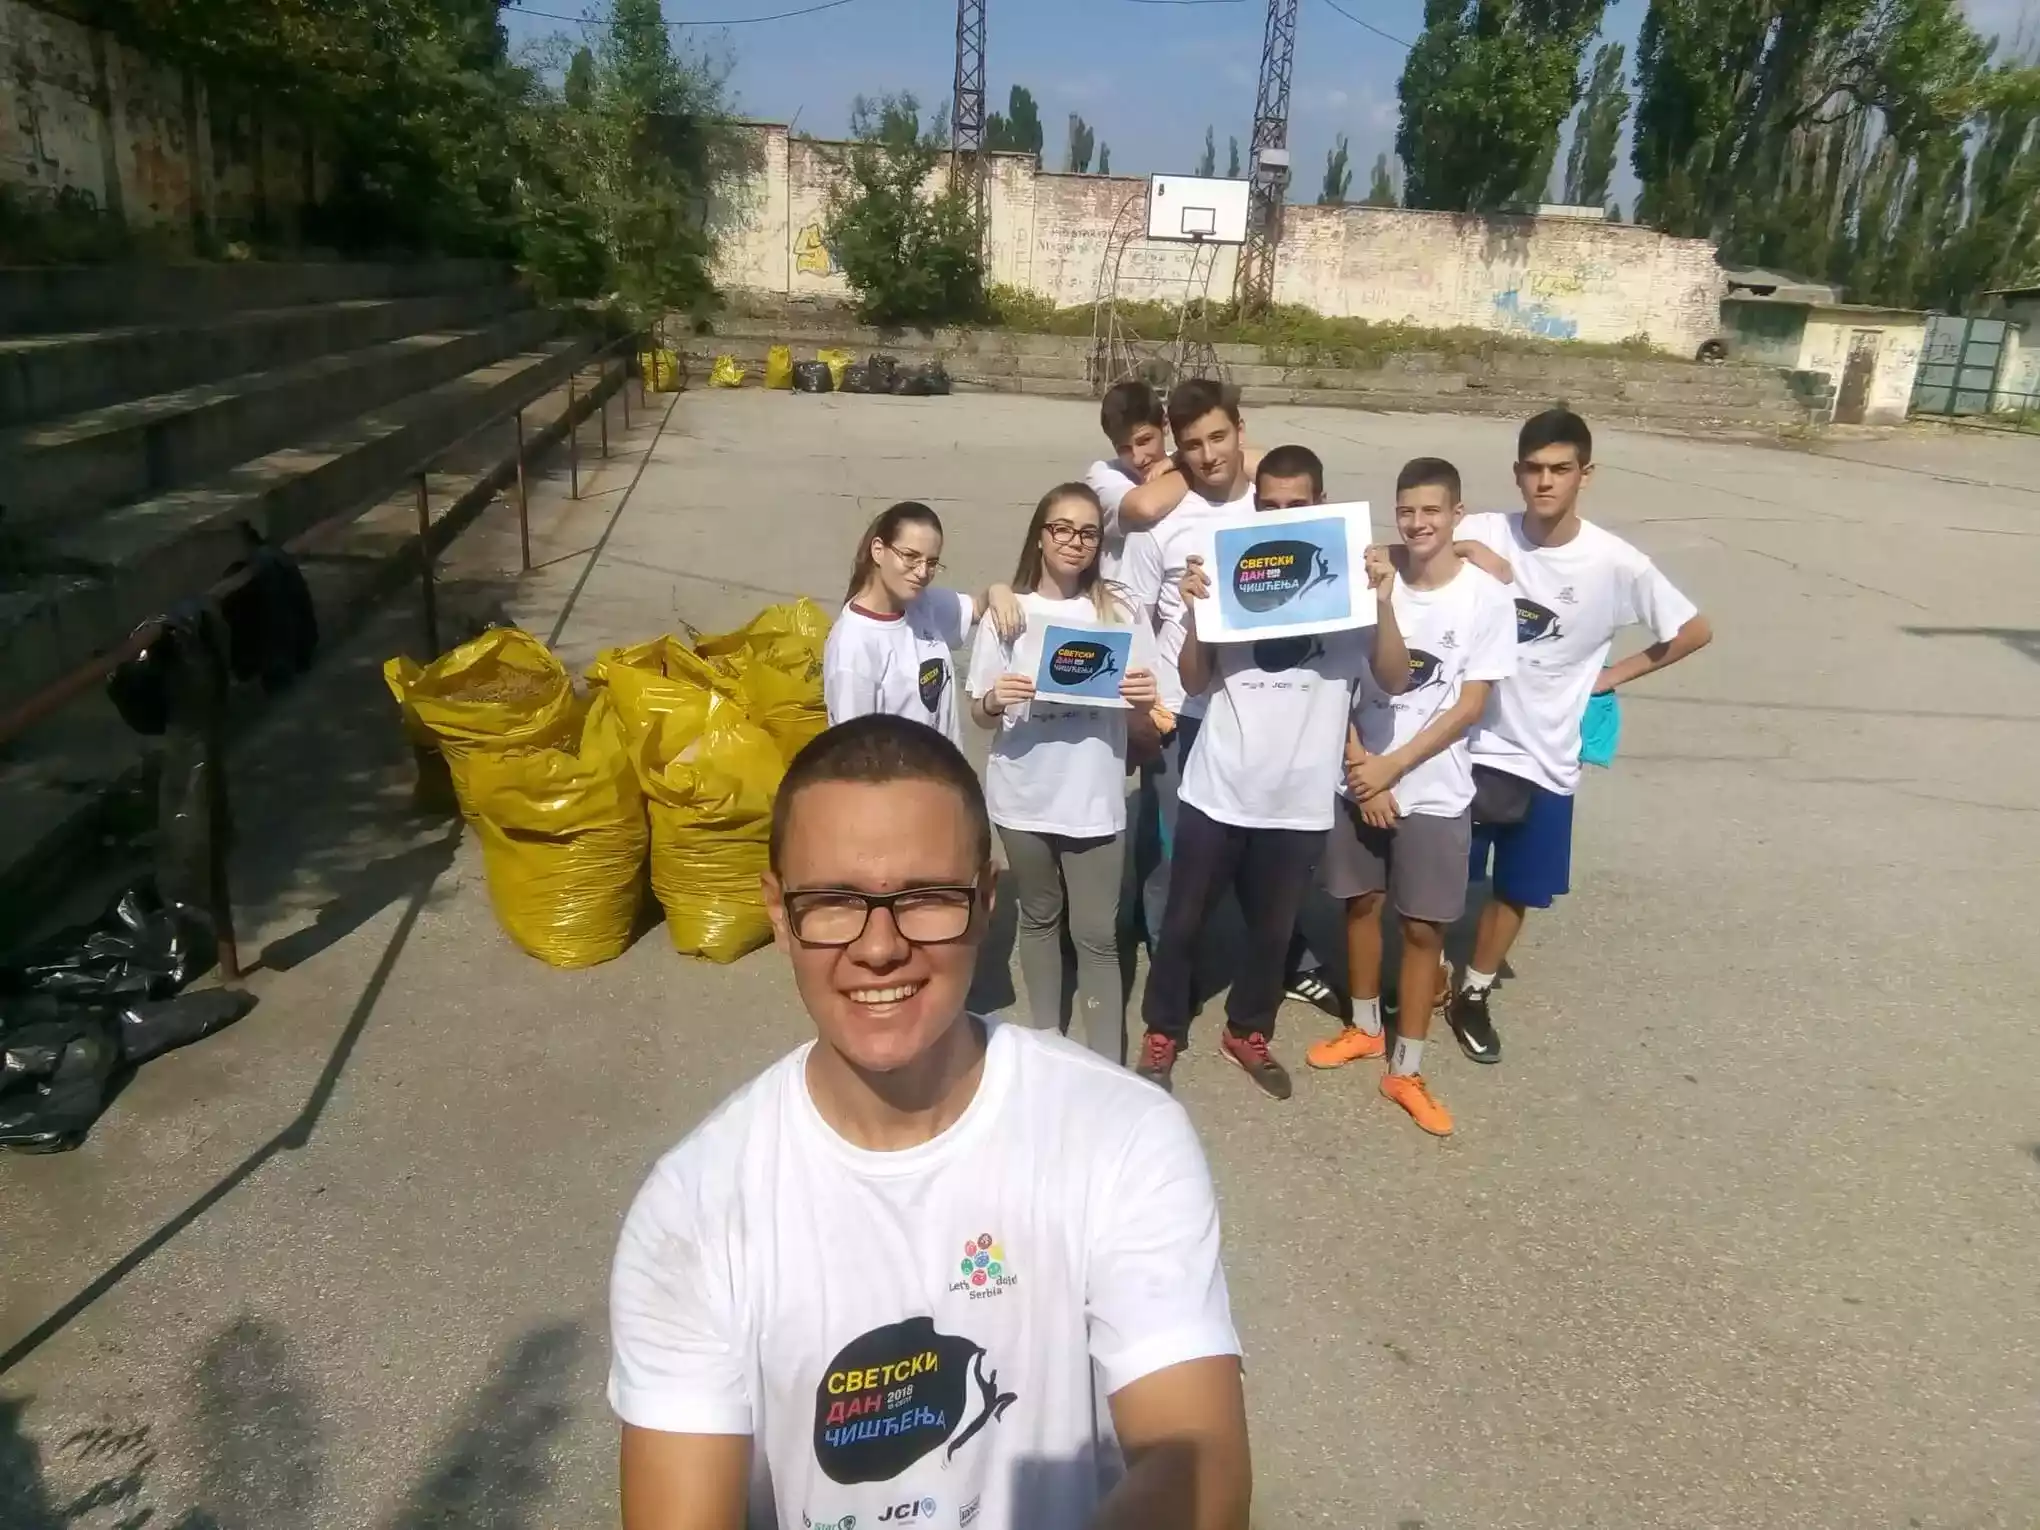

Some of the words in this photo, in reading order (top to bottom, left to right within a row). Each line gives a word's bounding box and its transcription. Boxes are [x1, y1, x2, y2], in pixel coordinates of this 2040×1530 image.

[1240, 555, 1294, 569] СВЕТСКИ
[1239, 579, 1299, 592] ЧИШЋЕЊА
[1240, 570, 1265, 583] ДАН
[969, 1286, 1003, 1299] Serbia
[827, 1351, 938, 1394] СВЕТСКИ
[826, 1394, 882, 1426] ДАН
[886, 1384, 914, 1404] 2018
[825, 1405, 947, 1447] ЧИШЋЕЊА
[878, 1500, 920, 1522] JCI
